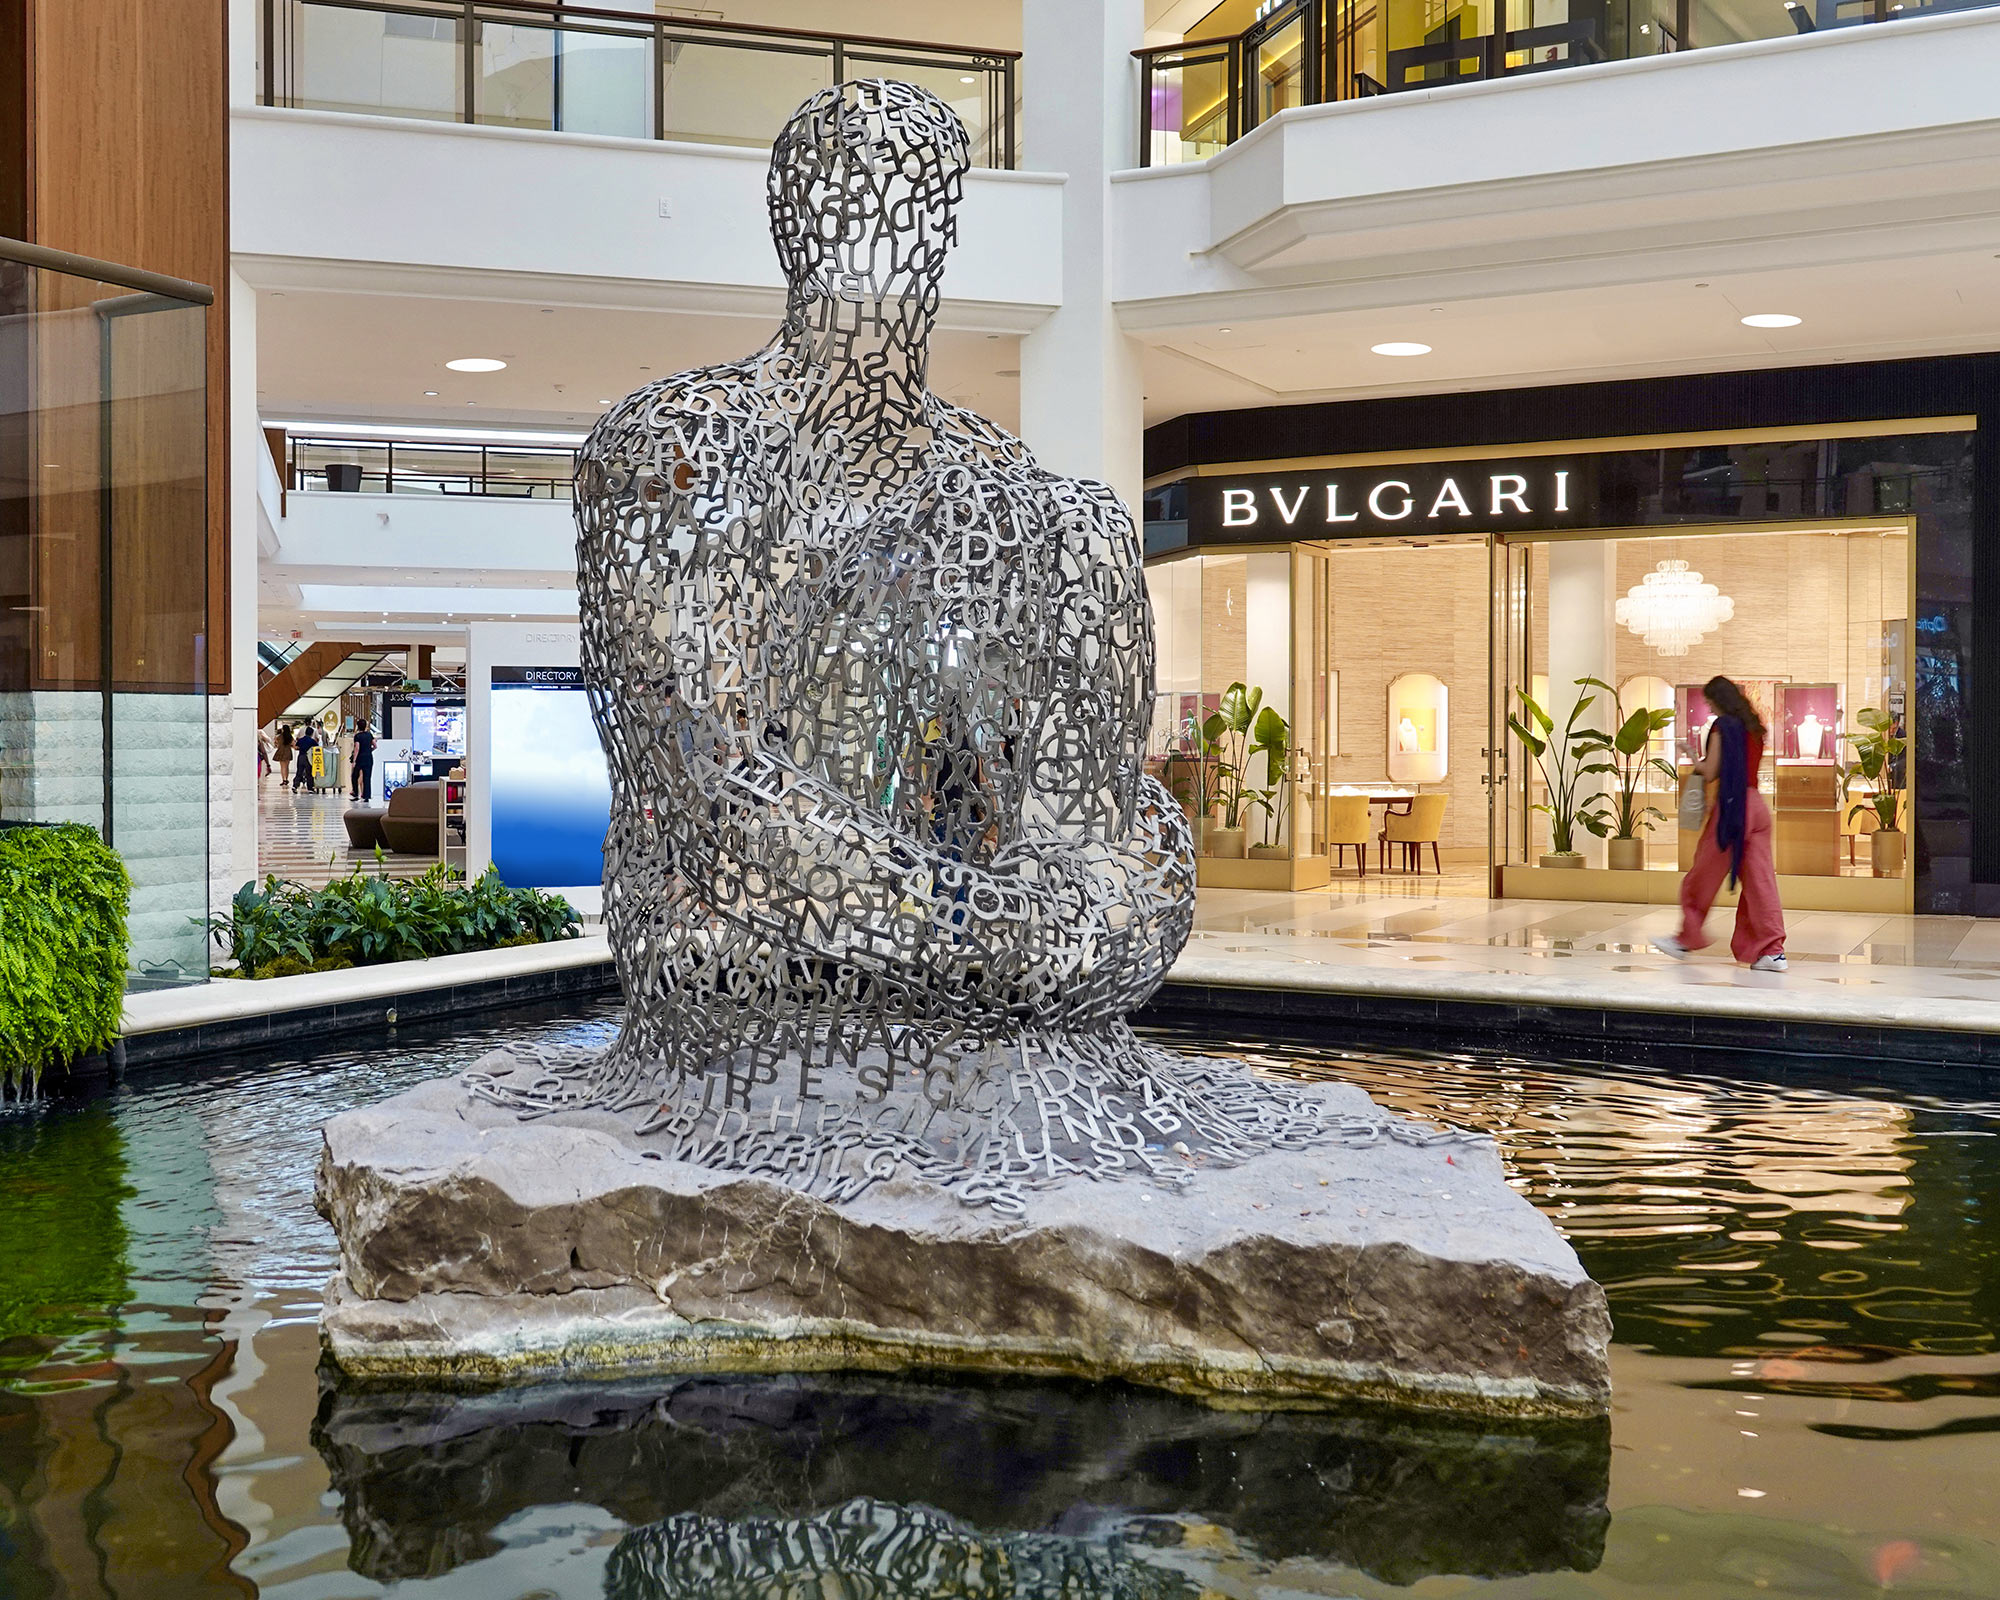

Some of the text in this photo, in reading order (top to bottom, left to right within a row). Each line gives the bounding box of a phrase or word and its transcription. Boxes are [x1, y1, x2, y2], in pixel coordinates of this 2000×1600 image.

[1221, 470, 1570, 527] BVLGARI
[525, 632, 577, 643] DIRECTORY
[525, 671, 578, 681] DIRECTORY
